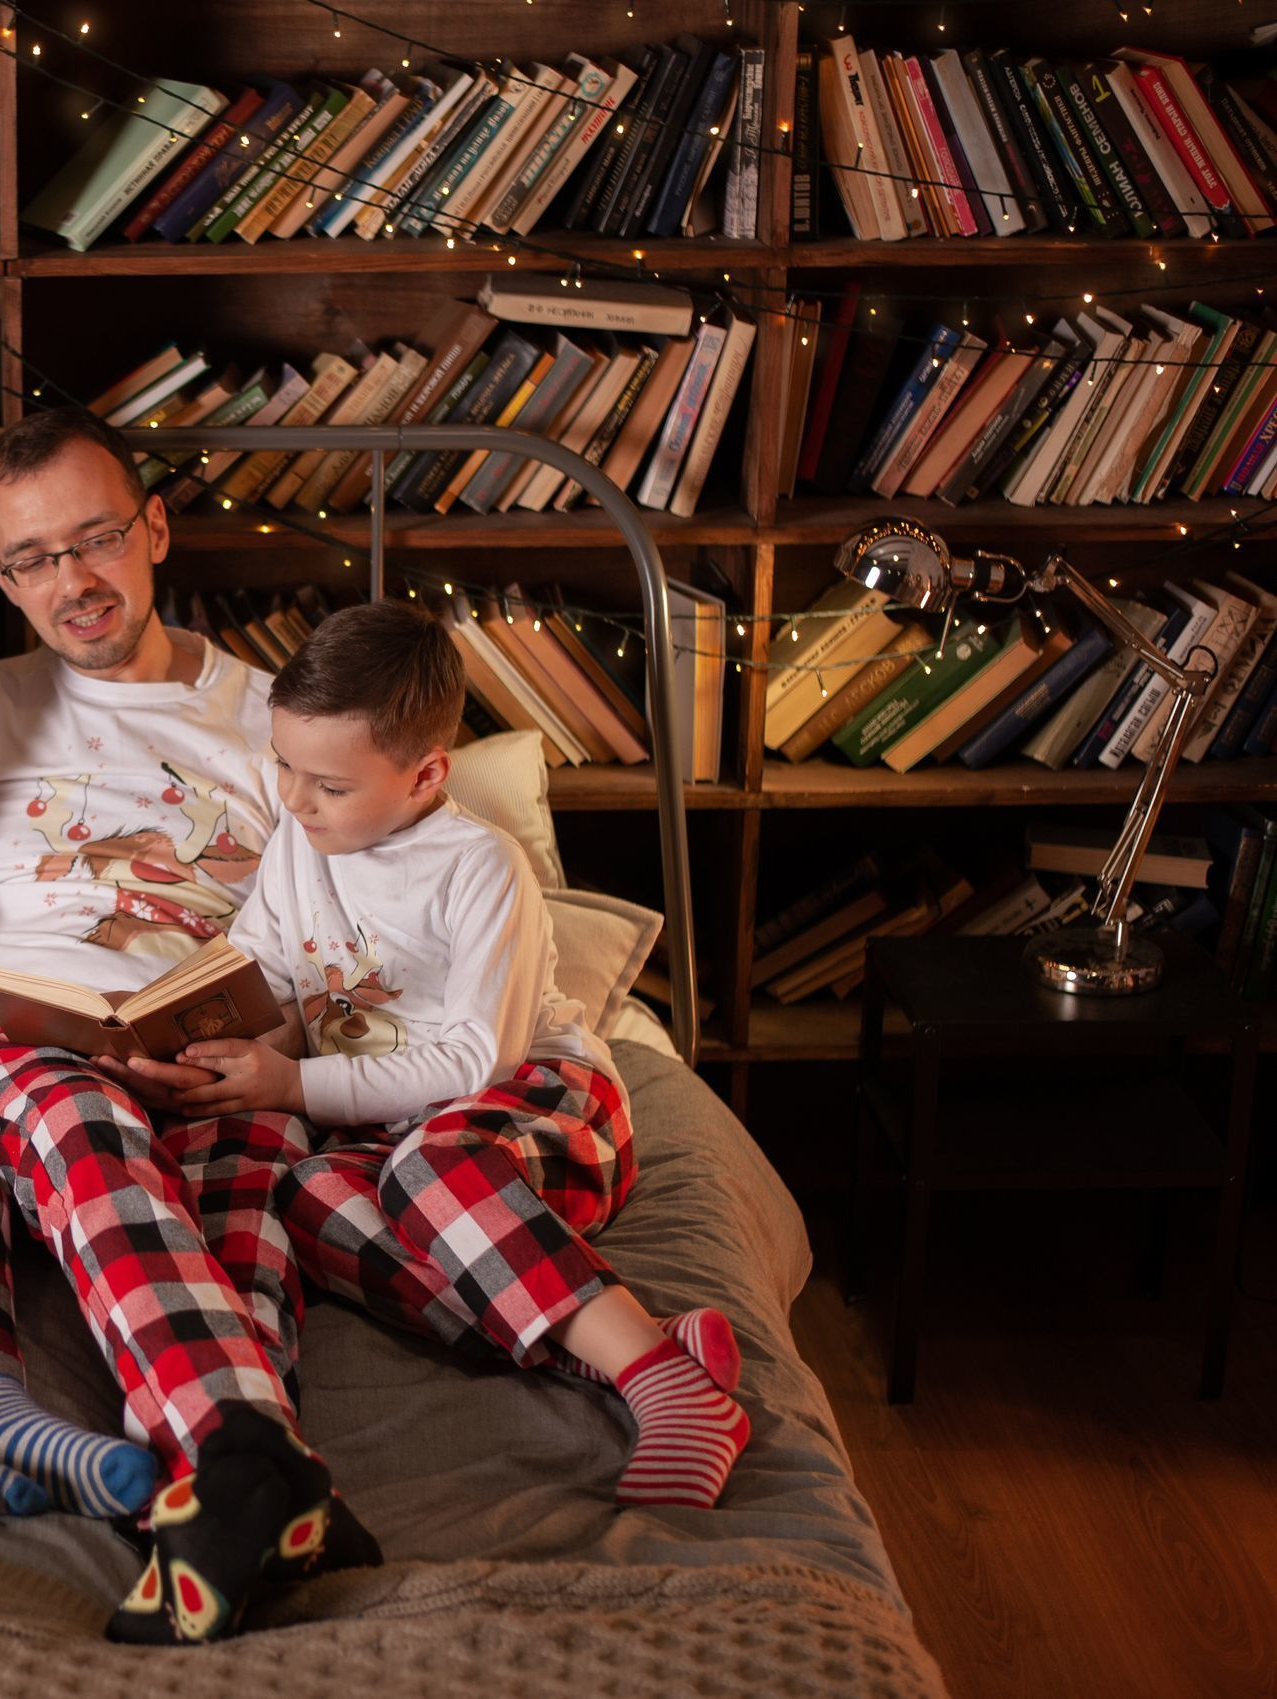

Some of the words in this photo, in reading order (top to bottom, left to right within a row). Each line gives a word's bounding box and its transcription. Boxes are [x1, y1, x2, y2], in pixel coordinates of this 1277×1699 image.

[1051, 94, 1084, 146] ФАНТАСТИКИ
[1069, 82, 1111, 155] СЕМЕНОВ
[1164, 103, 1188, 136] СТАРЫЙ
[1077, 146, 1102, 186] ШЕДЕВРЫ
[1183, 136, 1206, 168] МИЛЫЙ
[121, 160, 157, 196] ИСТИННАЯ
[1201, 167, 1217, 188] ЭТОТ
